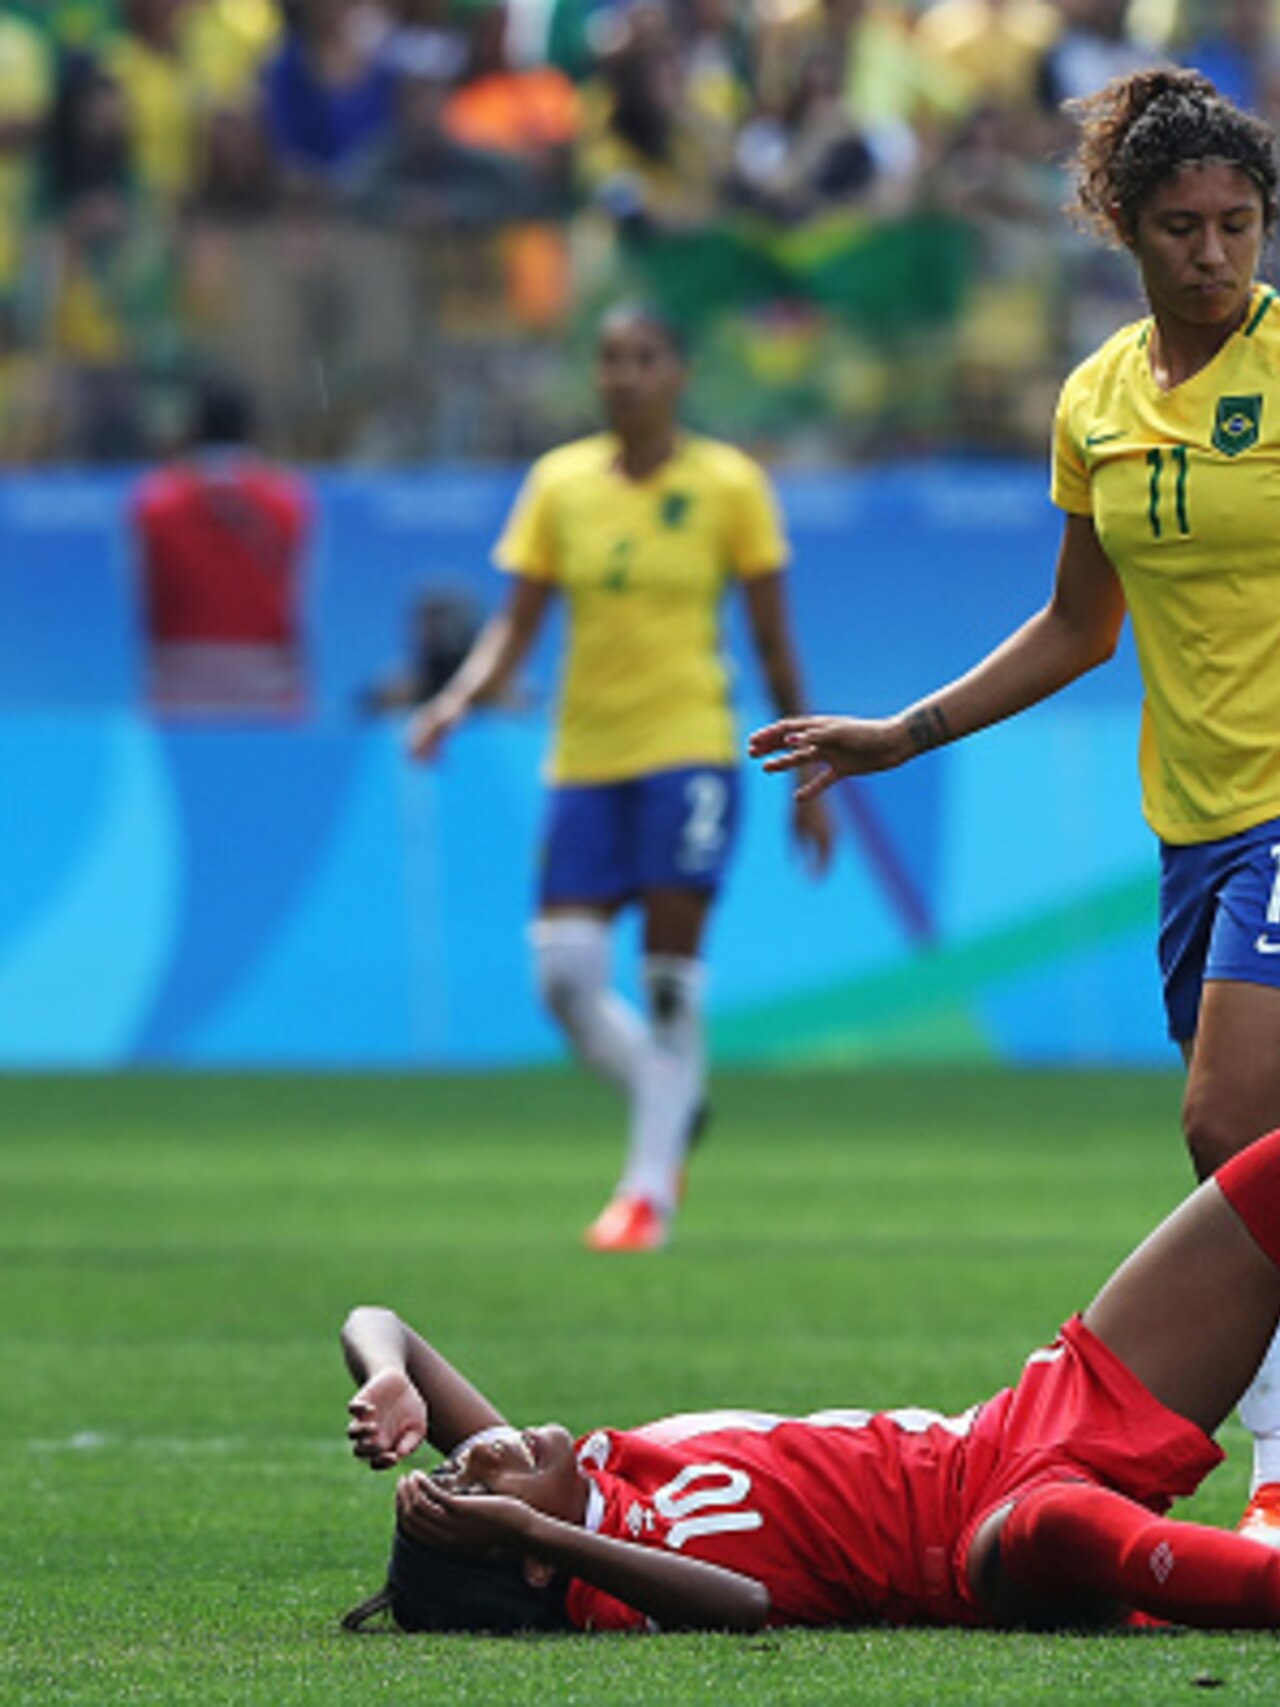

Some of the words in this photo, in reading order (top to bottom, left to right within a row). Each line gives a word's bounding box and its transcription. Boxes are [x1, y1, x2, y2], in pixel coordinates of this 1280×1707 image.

[1146, 447, 1189, 537] 11
[683, 774, 726, 849] 2
[654, 1463, 762, 1548] 10
